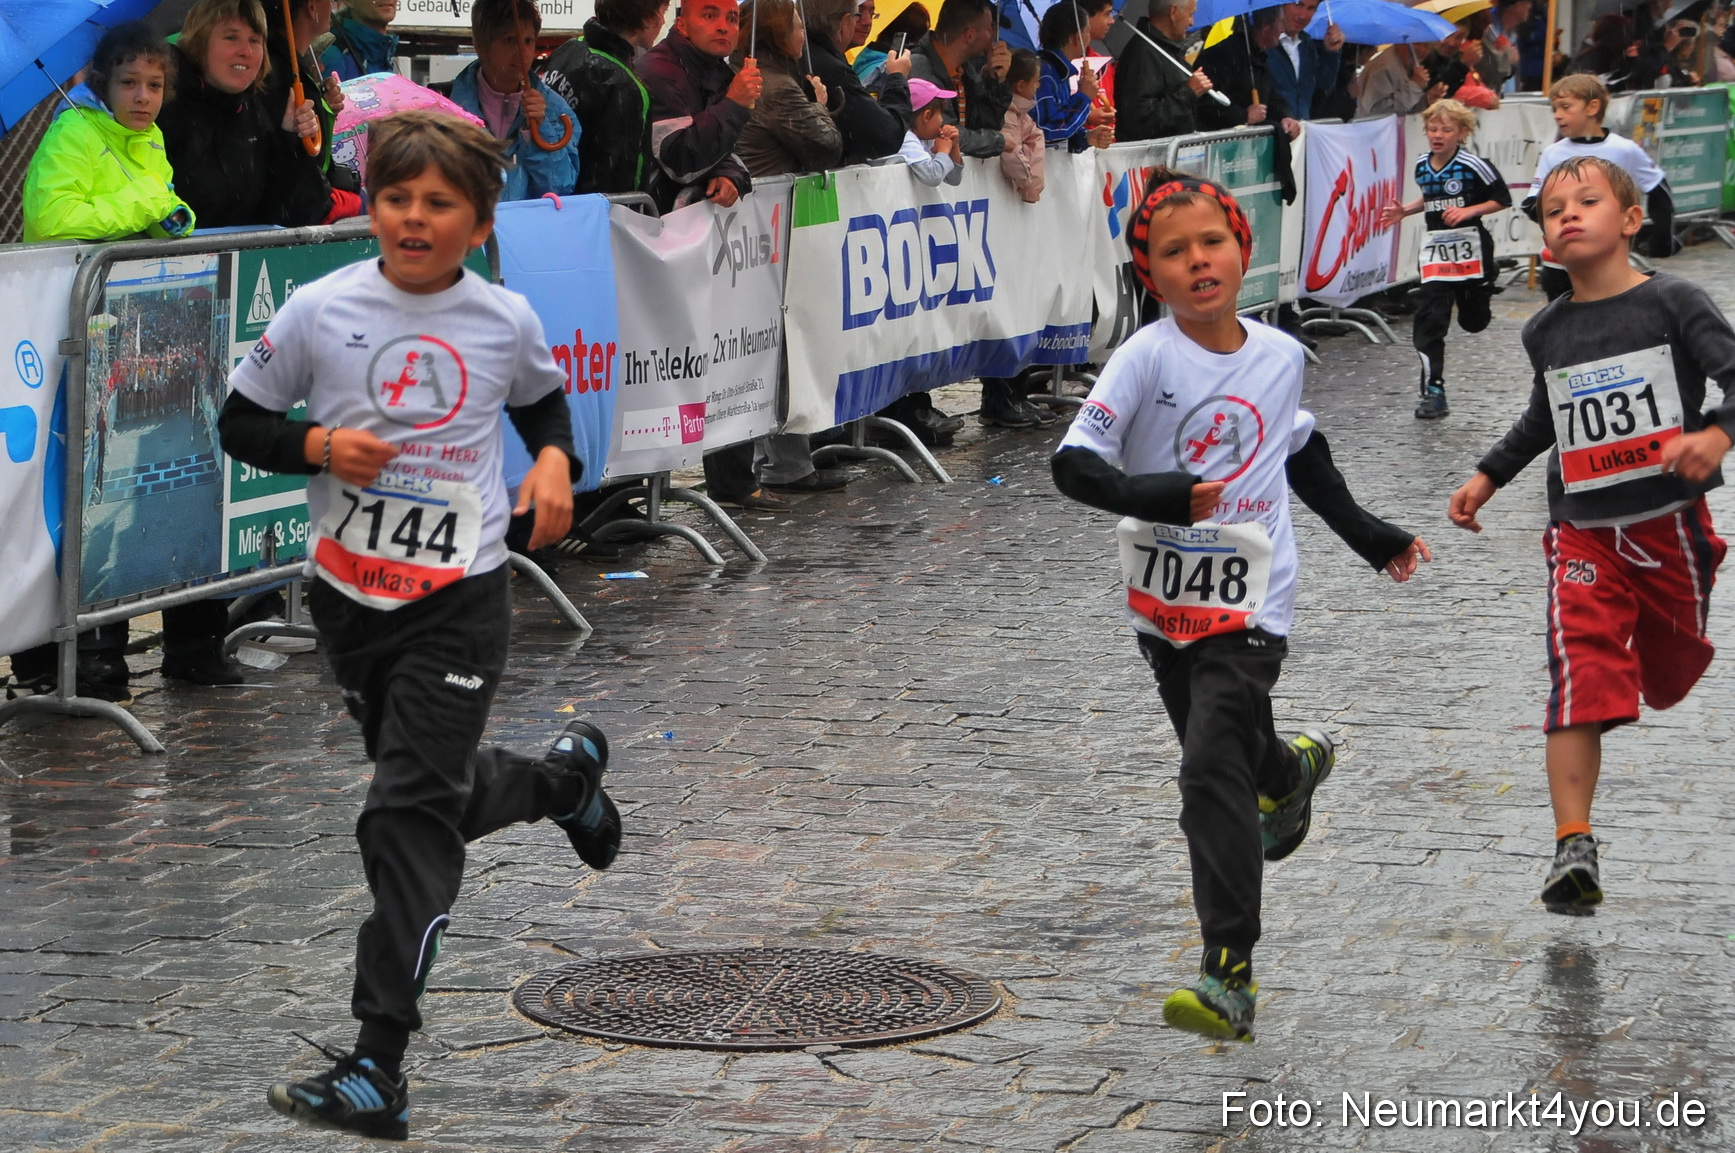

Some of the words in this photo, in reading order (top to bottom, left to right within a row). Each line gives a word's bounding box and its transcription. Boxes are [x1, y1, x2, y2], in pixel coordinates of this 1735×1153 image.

[540, 0, 573, 15] mbH
[841, 198, 997, 331] BOCK
[1425, 241, 1473, 262] 7013
[551, 328, 617, 395] nter
[625, 350, 650, 385] Ihr
[713, 332, 727, 365] 2x
[728, 328, 738, 360] in
[1569, 365, 1625, 389] BOCK
[682, 414, 705, 434] Partn
[1082, 404, 1115, 430] ADU
[1558, 383, 1662, 446] 7031
[400, 442, 433, 458] MIT
[441, 444, 480, 463] HERZ
[1589, 446, 1648, 473] Lukas
[377, 472, 434, 494] OCK
[334, 488, 458, 564] 7144
[1153, 525, 1221, 544] BOCK
[1133, 543, 1249, 606] 7048
[1563, 559, 1597, 586] 25
[445, 672, 476, 689] JAKO
